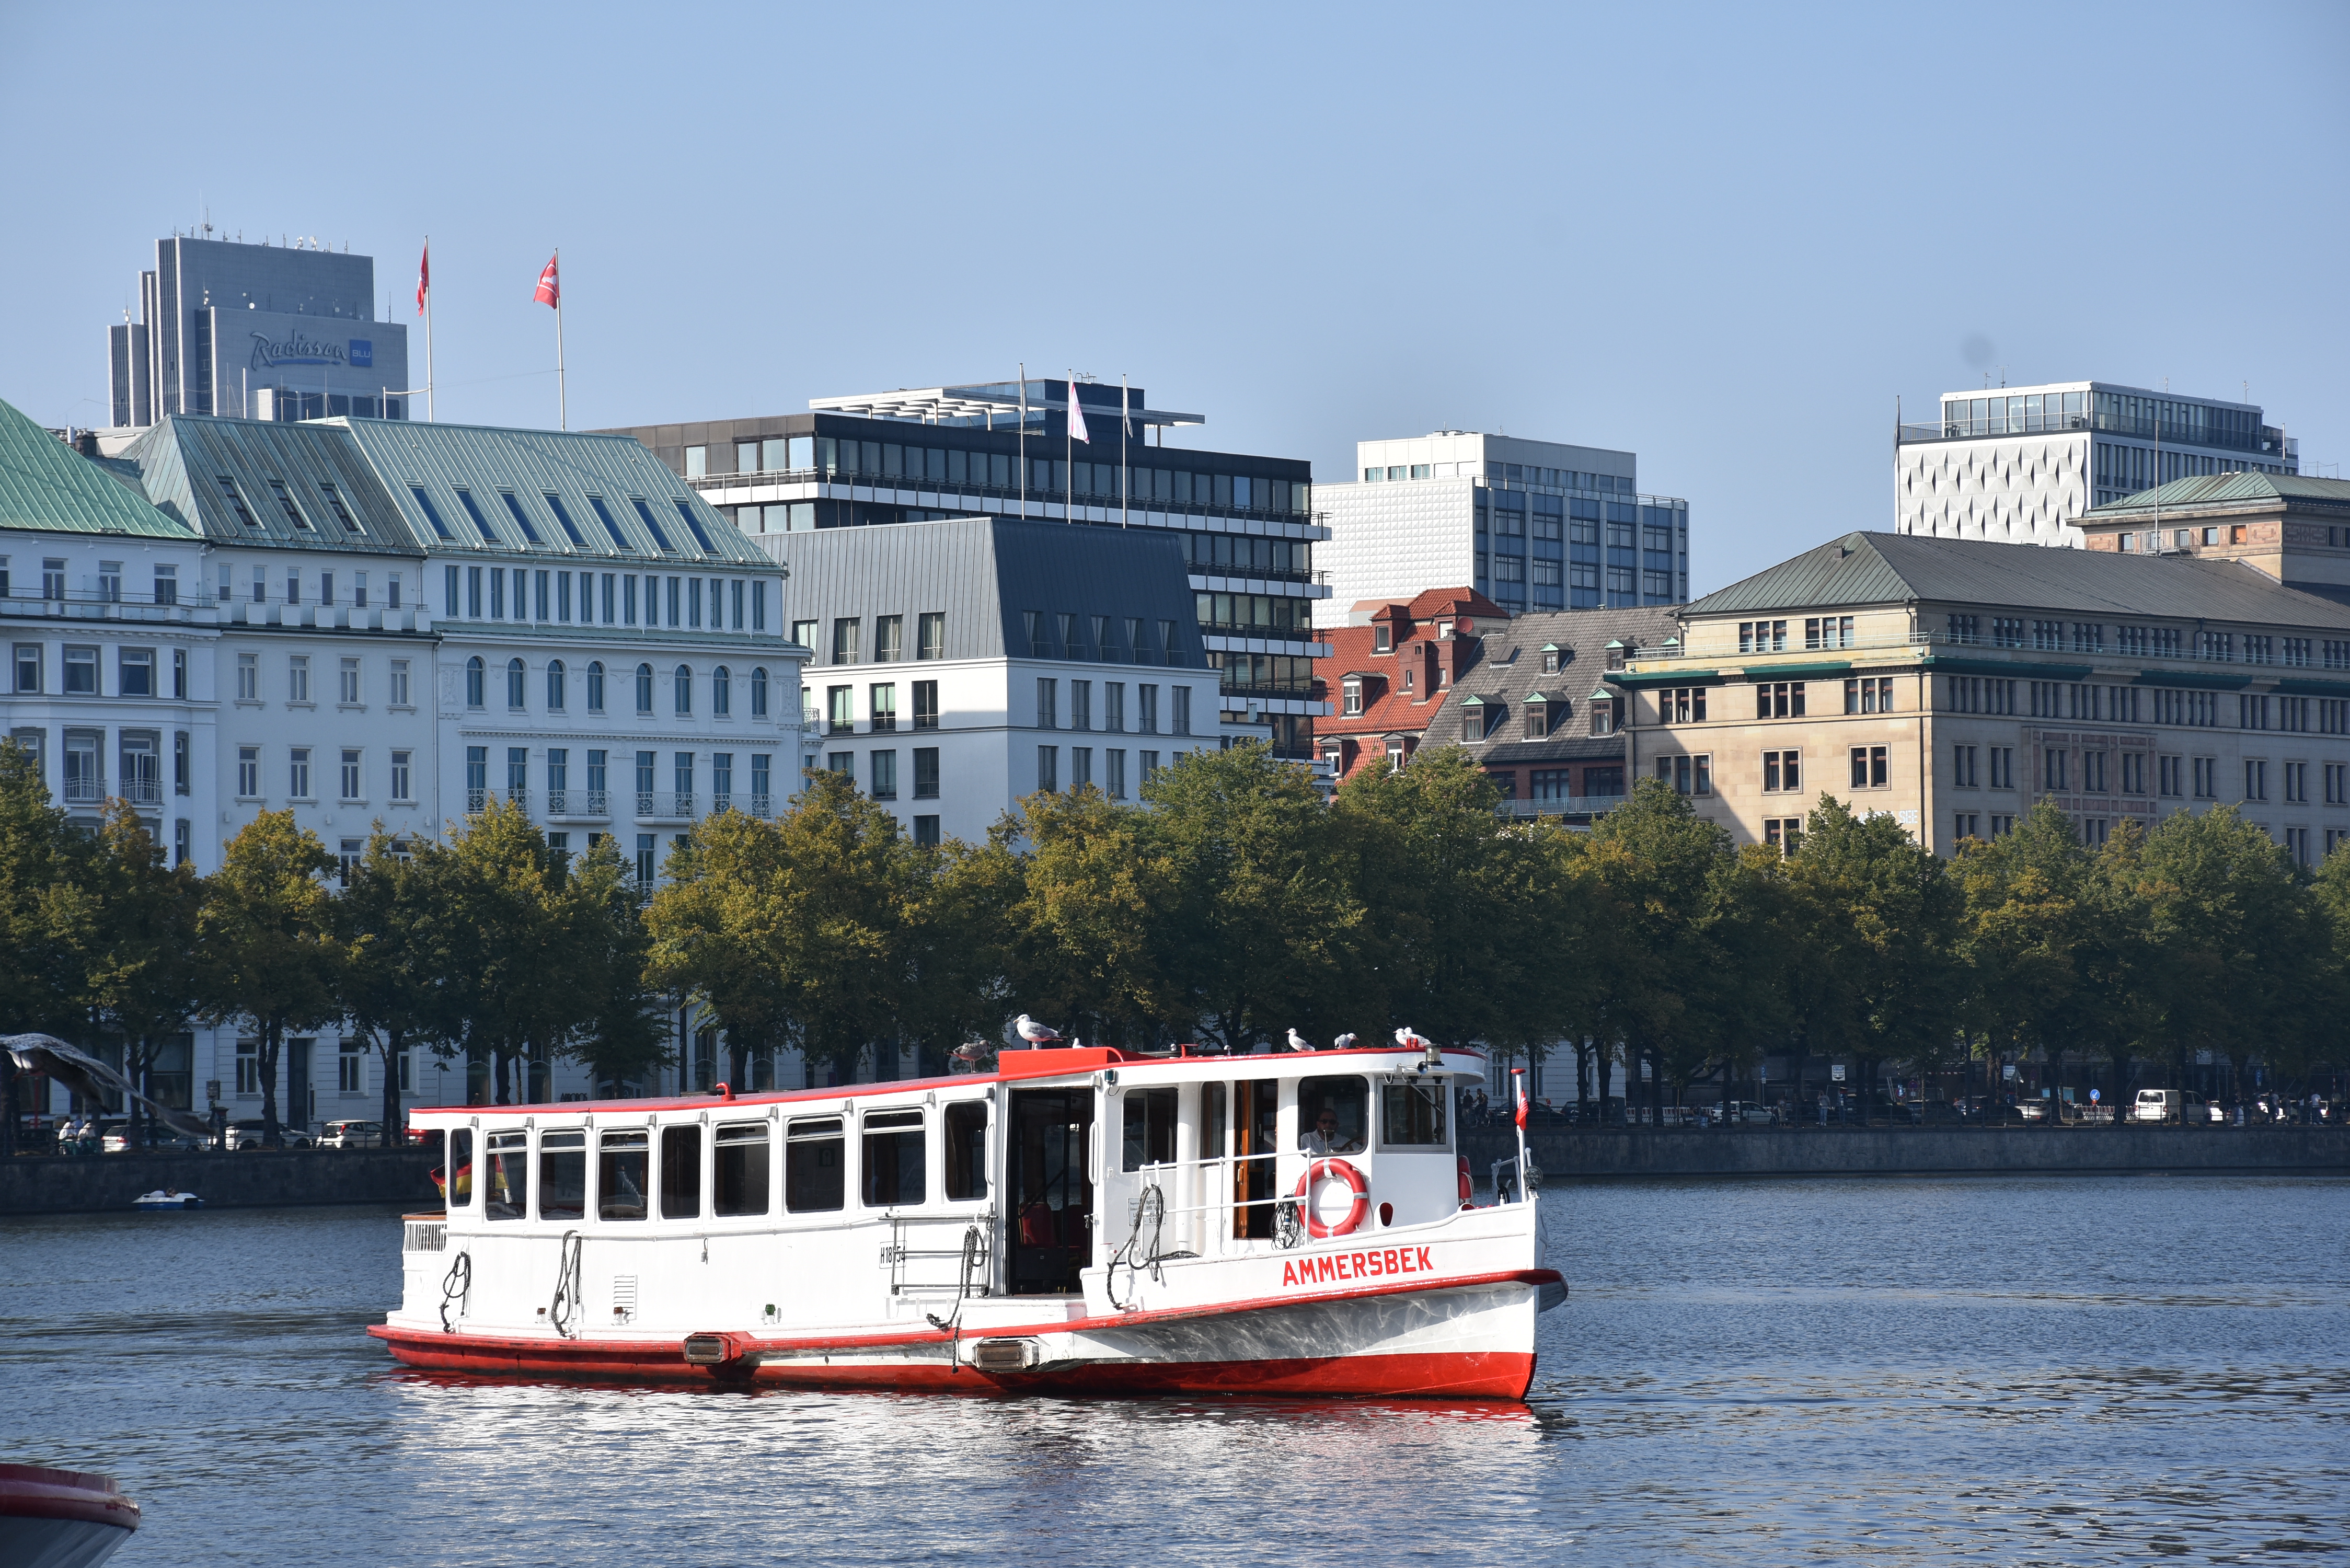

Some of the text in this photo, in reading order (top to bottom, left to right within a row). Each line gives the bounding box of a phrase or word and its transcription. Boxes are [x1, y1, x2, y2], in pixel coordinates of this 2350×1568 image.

[250, 329, 371, 372] Radisson BLU
[1899, 810, 1918, 824] SEE
[881, 1246, 906, 1264] H1854
[1283, 1247, 1434, 1287] AMMERSBEK
